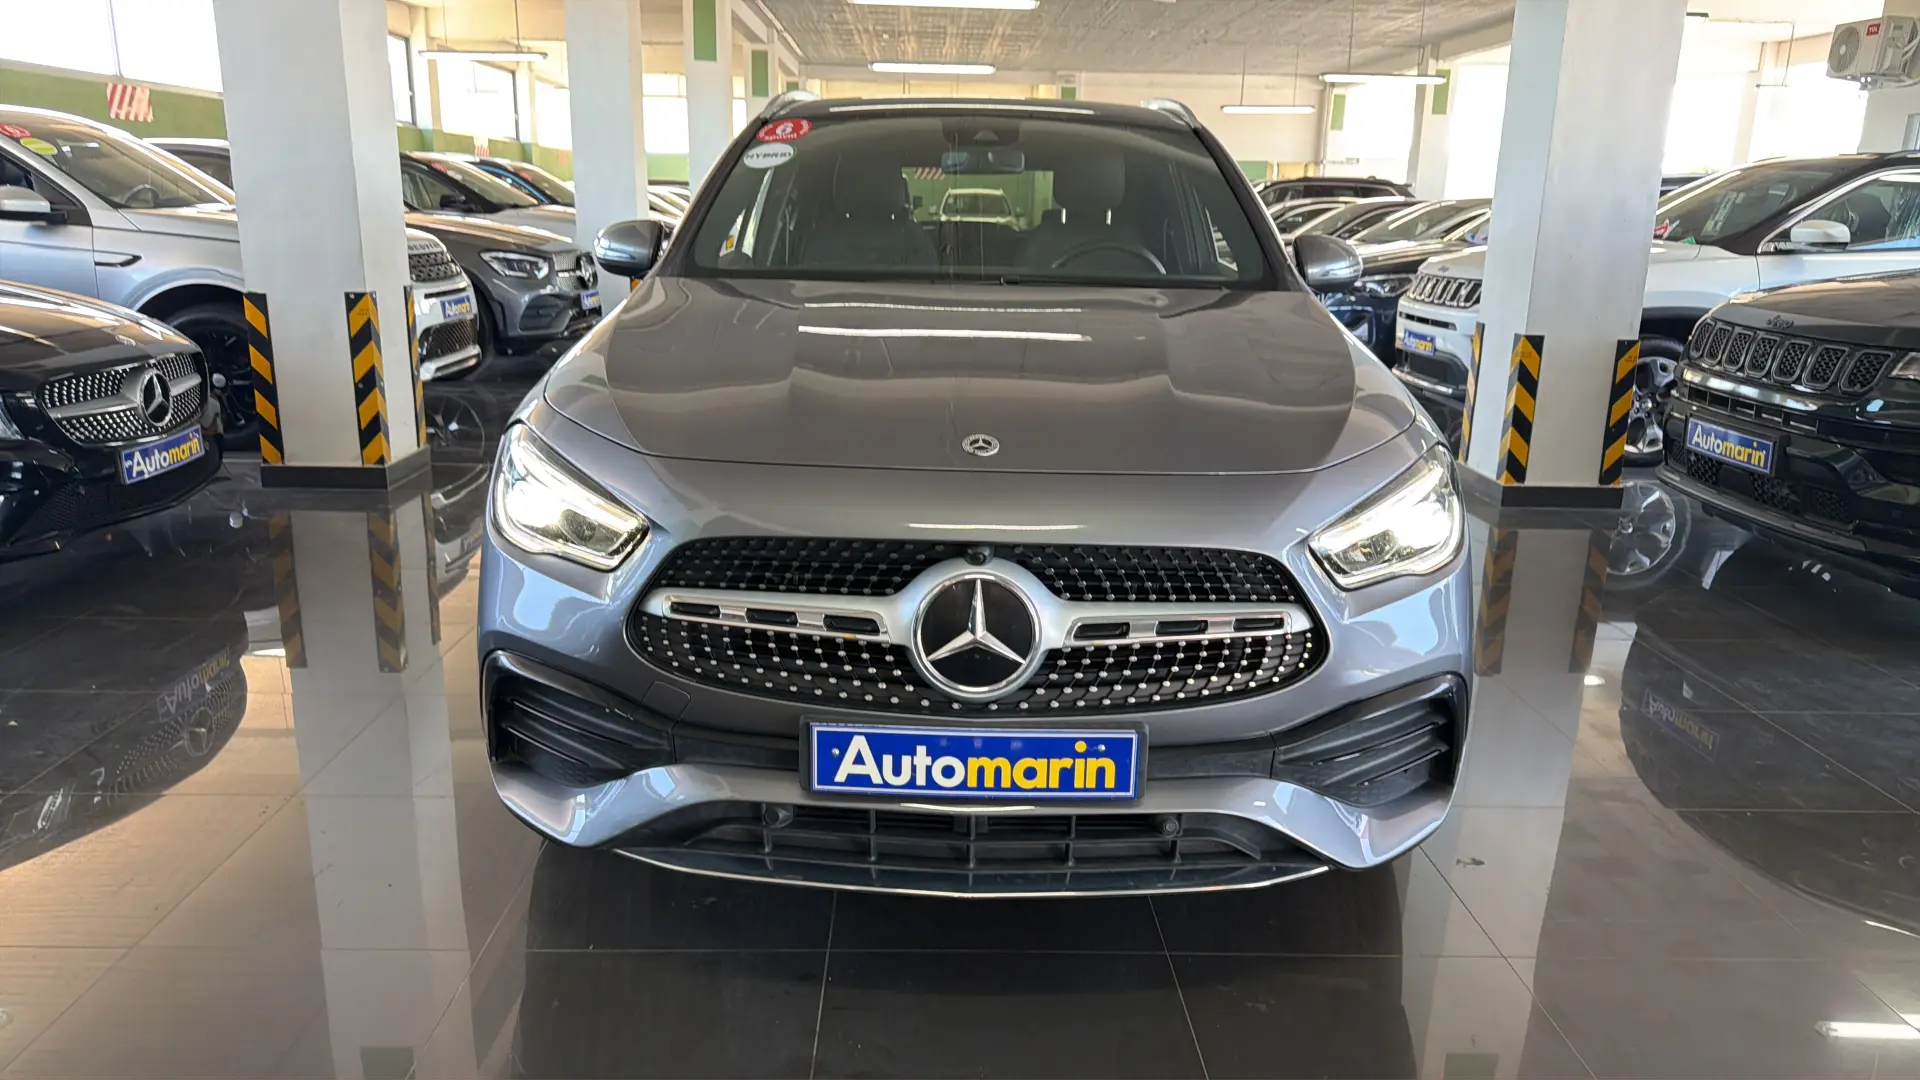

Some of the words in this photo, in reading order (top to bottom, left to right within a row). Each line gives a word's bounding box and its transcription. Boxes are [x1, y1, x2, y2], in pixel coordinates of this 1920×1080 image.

[132, 432, 200, 477] Automarin
[1692, 424, 1766, 468] Automarin
[833, 735, 1116, 789] Automarin
